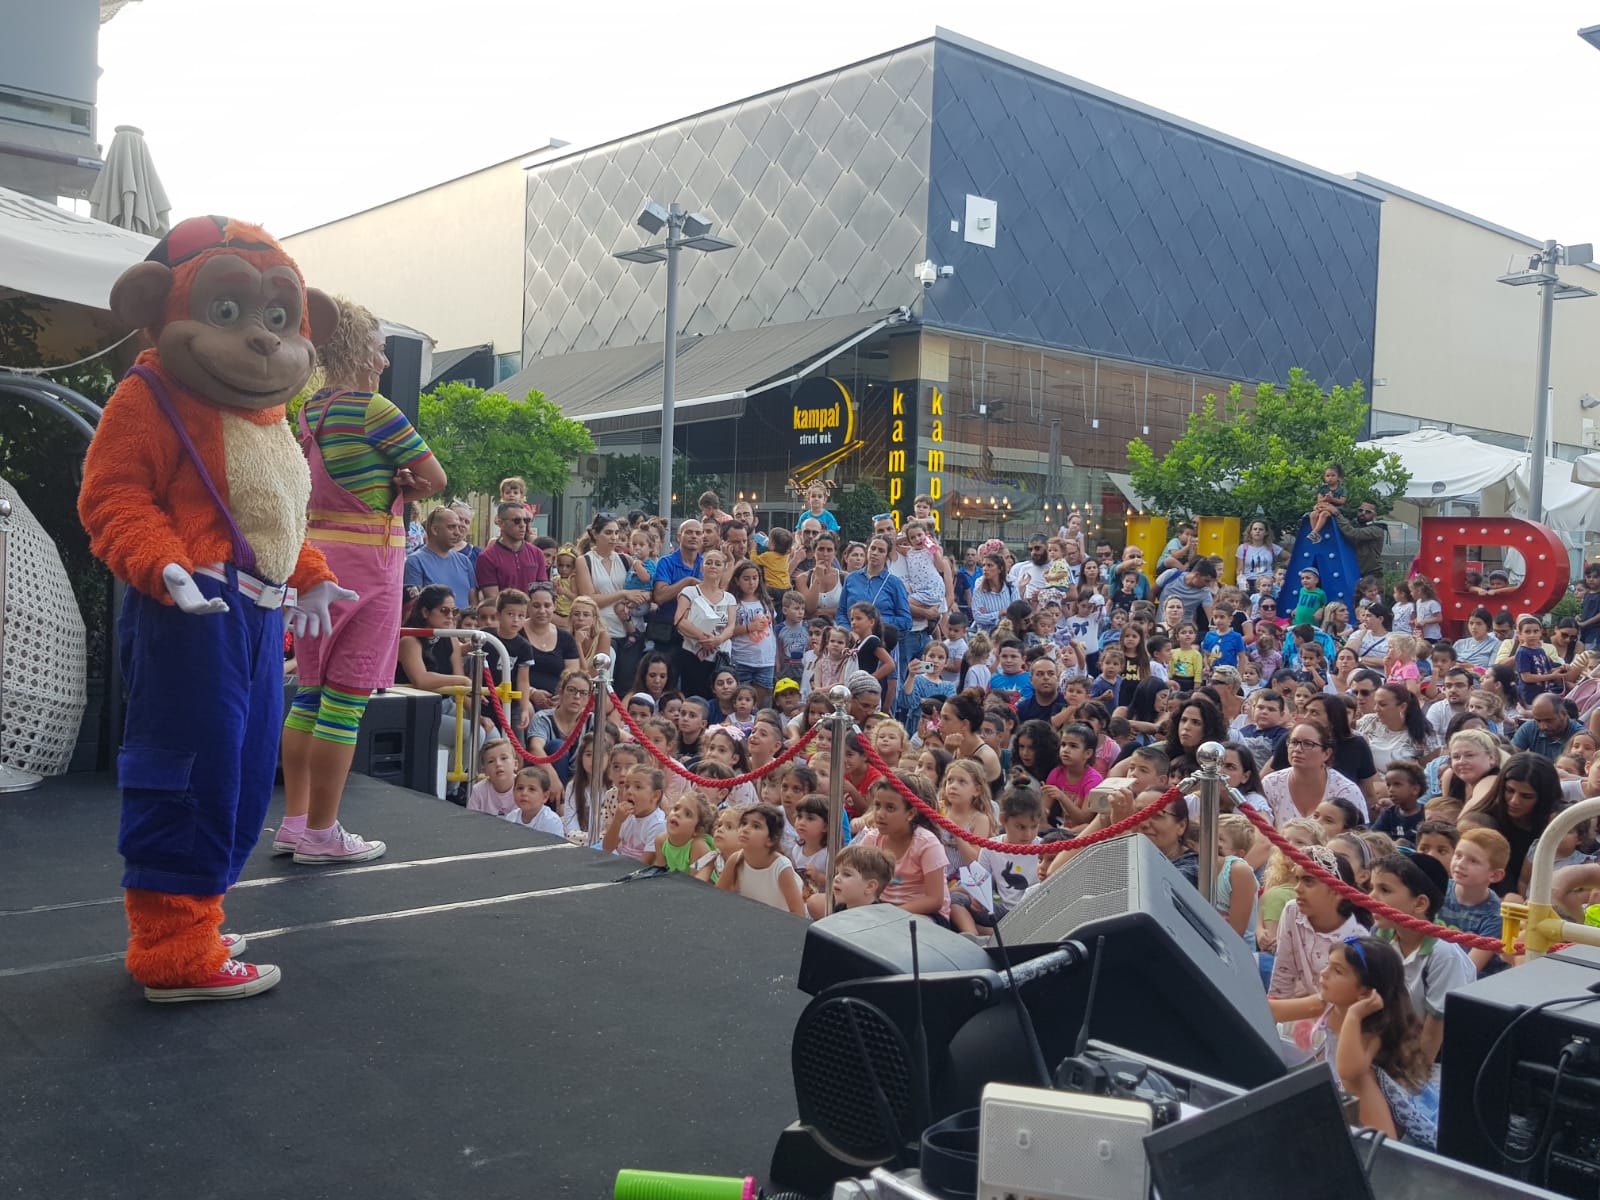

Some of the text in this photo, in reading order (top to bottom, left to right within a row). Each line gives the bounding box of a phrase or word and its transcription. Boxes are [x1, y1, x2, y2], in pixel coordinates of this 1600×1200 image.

[793, 402, 840, 432] kampai
[800, 431, 832, 445] street wok
